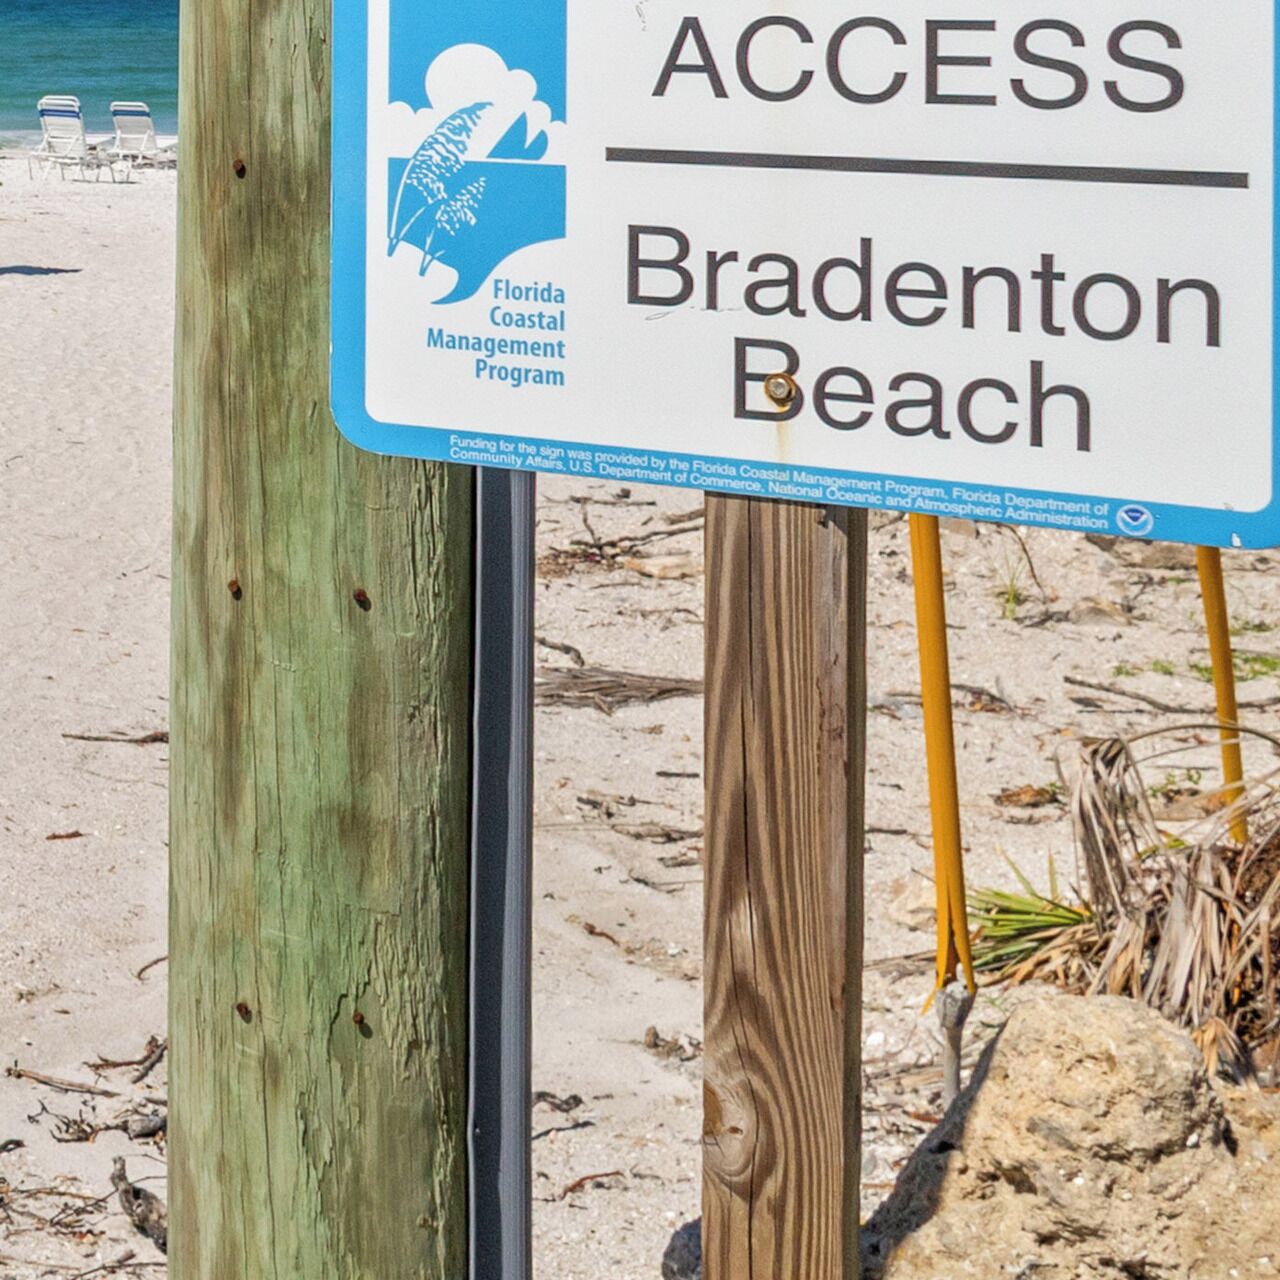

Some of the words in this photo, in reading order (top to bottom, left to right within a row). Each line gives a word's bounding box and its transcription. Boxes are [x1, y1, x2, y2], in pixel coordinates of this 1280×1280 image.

[652, 16, 1185, 113] ACCESS
[490, 306, 565, 331] Coastal
[493, 279, 565, 304] Florida
[628, 224, 1221, 348] Bradenton
[427, 327, 565, 359] Management
[475, 359, 565, 386] Program
[735, 336, 1091, 452] Beach
[450, 435, 496, 452] Funding
[500, 441, 515, 452] for
[518, 442, 536, 454] the
[540, 445, 564, 458] sign
[568, 449, 592, 460] was
[596, 452, 648, 467] provided
[651, 457, 667, 468] by
[670, 457, 689, 470] the
[693, 460, 736, 475] Florida
[740, 465, 790, 481] Coastal
[793, 471, 881, 492] Management
[953, 487, 1001, 504] Florida
[1005, 493, 1091, 514] Department
[1094, 504, 1108, 515] of
[450, 447, 522, 466] Community
[569, 460, 595, 473] U.S.
[600, 464, 672, 482] Department
[675, 471, 687, 482] of
[769, 482, 822, 499] National
[826, 487, 882, 504] Oceanic
[885, 493, 912, 507] and
[915, 497, 1002, 519] Atmospheric
[1005, 507, 1108, 529] Administration
